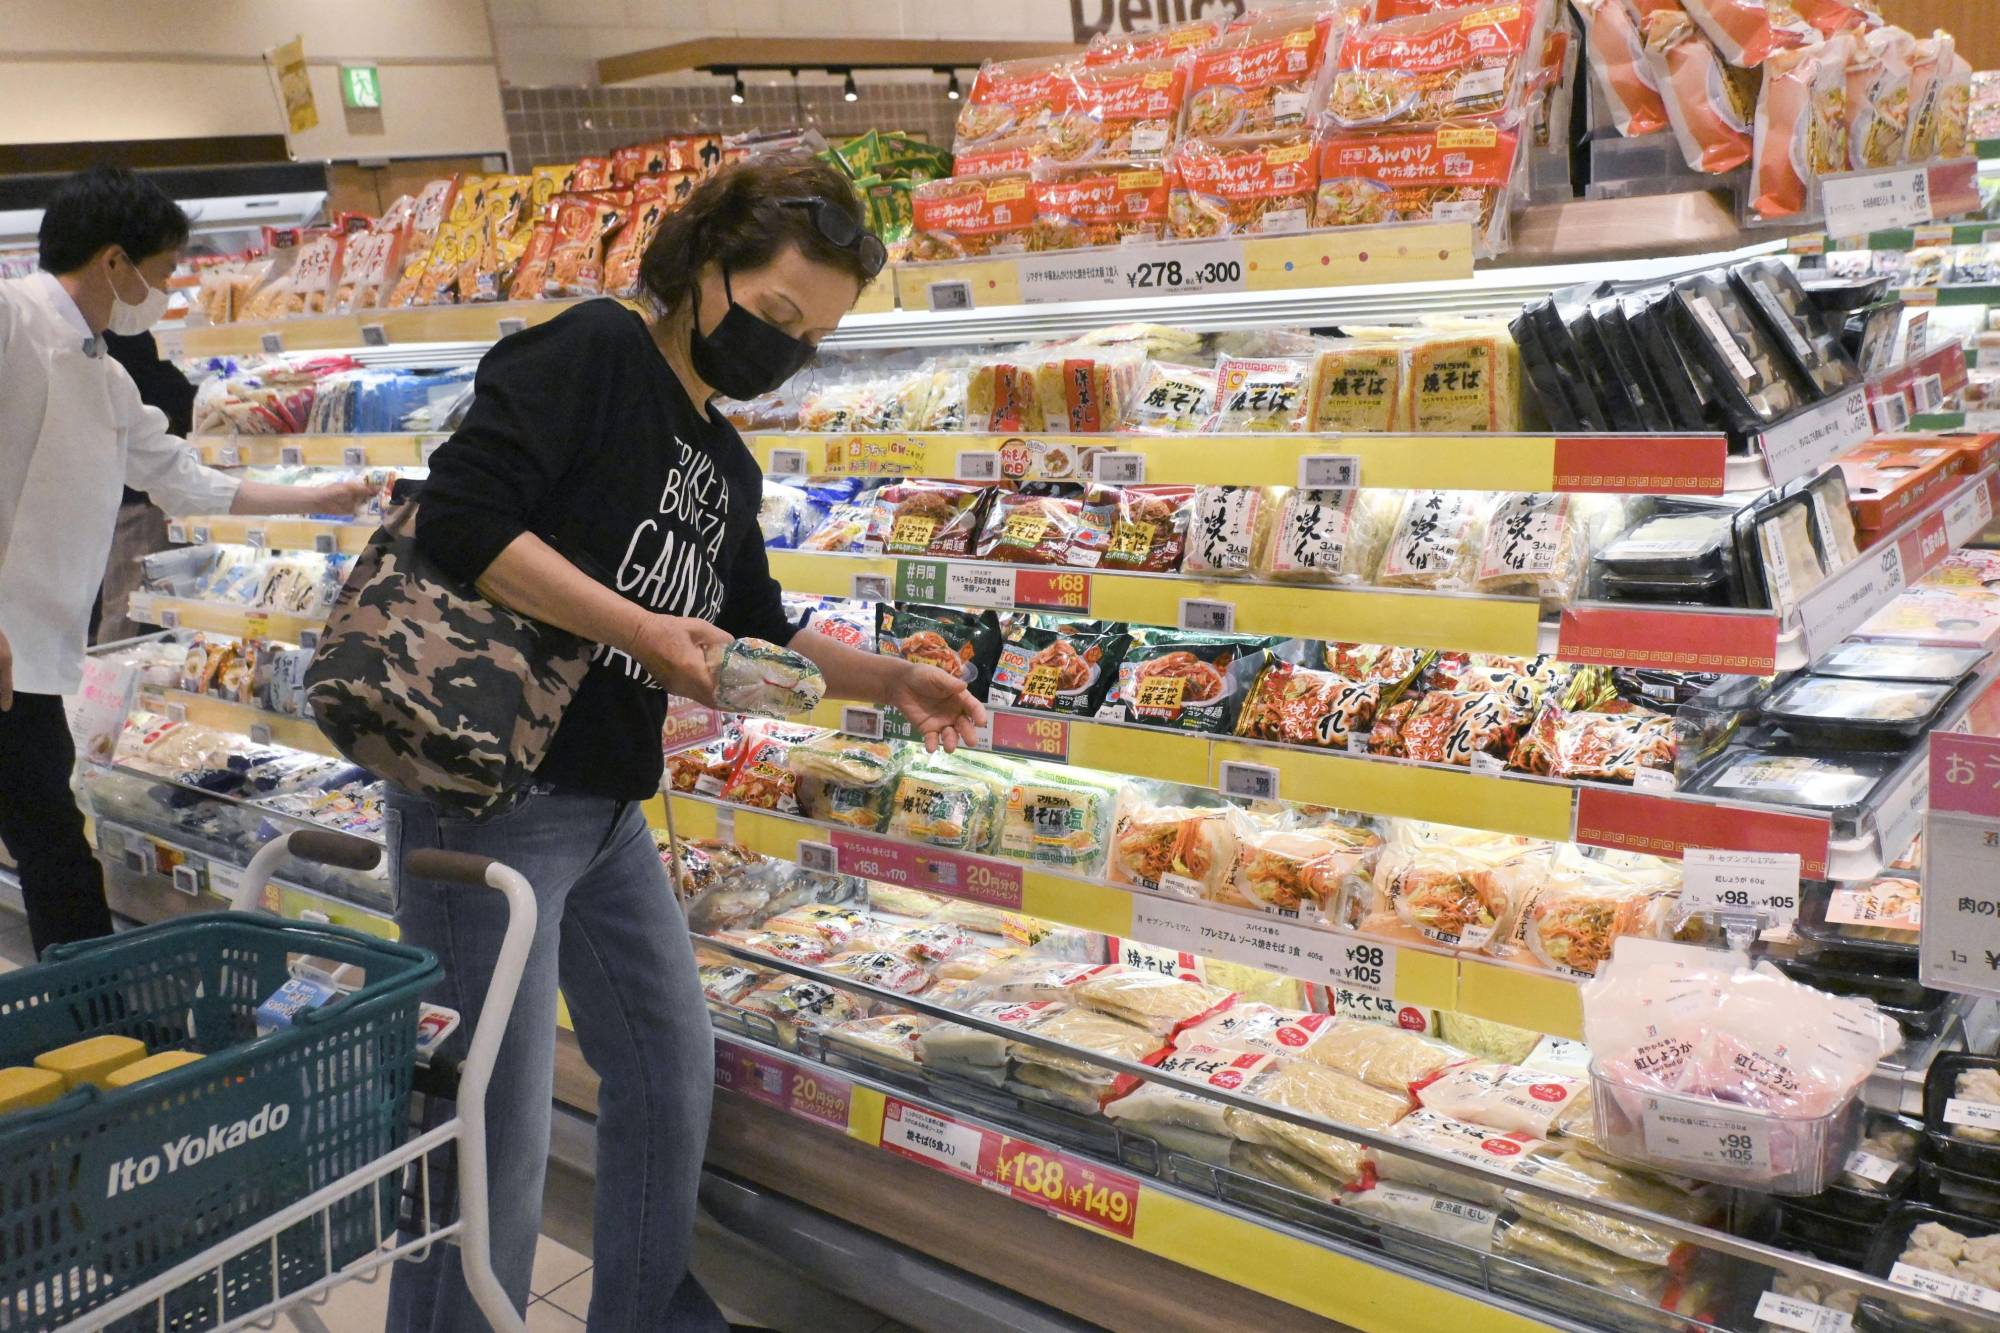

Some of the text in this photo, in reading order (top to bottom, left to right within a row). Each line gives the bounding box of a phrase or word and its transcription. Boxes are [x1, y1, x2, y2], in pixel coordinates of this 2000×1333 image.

[1368, 143, 1433, 164] あんかけ
[1126, 260, 1183, 289] ¥278
[1195, 260, 1241, 284] ¥300
[1330, 377, 1388, 397] 焼そば
[1422, 369, 1482, 394] 焼そば
[1293, 504, 1322, 568] 焼そば
[1319, 541, 1343, 552] 3人前
[1502, 511, 1534, 570] 焼そば
[1531, 541, 1557, 551] 3人前
[1226, 543, 1248, 554] 3人前
[1323, 553, 1339, 562] むし
[1533, 552, 1551, 561] むし
[616, 518, 702, 617] GAIN
[906, 564, 937, 581] #月間
[906, 584, 935, 601] 安い値
[1048, 573, 1085, 593] ¥168
[1058, 592, 1084, 608] ¥181
[1026, 682, 1056, 697] 焼そば
[1138, 694, 1178, 706] 焼そば
[1026, 719, 1063, 740] ¥168
[1035, 740, 1062, 755] ¥181
[1036, 794, 1071, 807] マルちゃん
[853, 860, 908, 882] ¥158 ¥170
[966, 865, 1019, 892] 20円分の
[1714, 875, 1748, 884] 紅しょうが
[1715, 890, 1749, 905] ¥98
[1761, 895, 1795, 909] ¥105
[1957, 897, 2000, 918] 肉の
[1200, 926, 1237, 943] 7プレミアム
[1238, 934, 1287, 954] ソース焼きそば
[1288, 945, 1302, 957] 3食
[1127, 948, 1178, 977] 焼そば
[1345, 944, 1385, 968] ¥98
[1950, 950, 1968, 964] 1コ
[1344, 964, 1383, 985] ¥105
[1335, 987, 1398, 1014] 焼そば
[1399, 1011, 1422, 1026] 5食入
[1633, 1041, 1693, 1071] 紅しょうが
[1733, 1052, 1801, 1092] 紅しょうが
[792, 1074, 846, 1113] 20円分の
[906, 1129, 956, 1157] 焼そば(5食入)
[1719, 1134, 1753, 1149] ¥98
[1719, 1149, 1753, 1161] ¥105
[996, 1150, 1064, 1201] ¥138
[1064, 1179, 1133, 1226] (¥149)
[1433, 1200, 1487, 1221] 要冷蔵 むし
